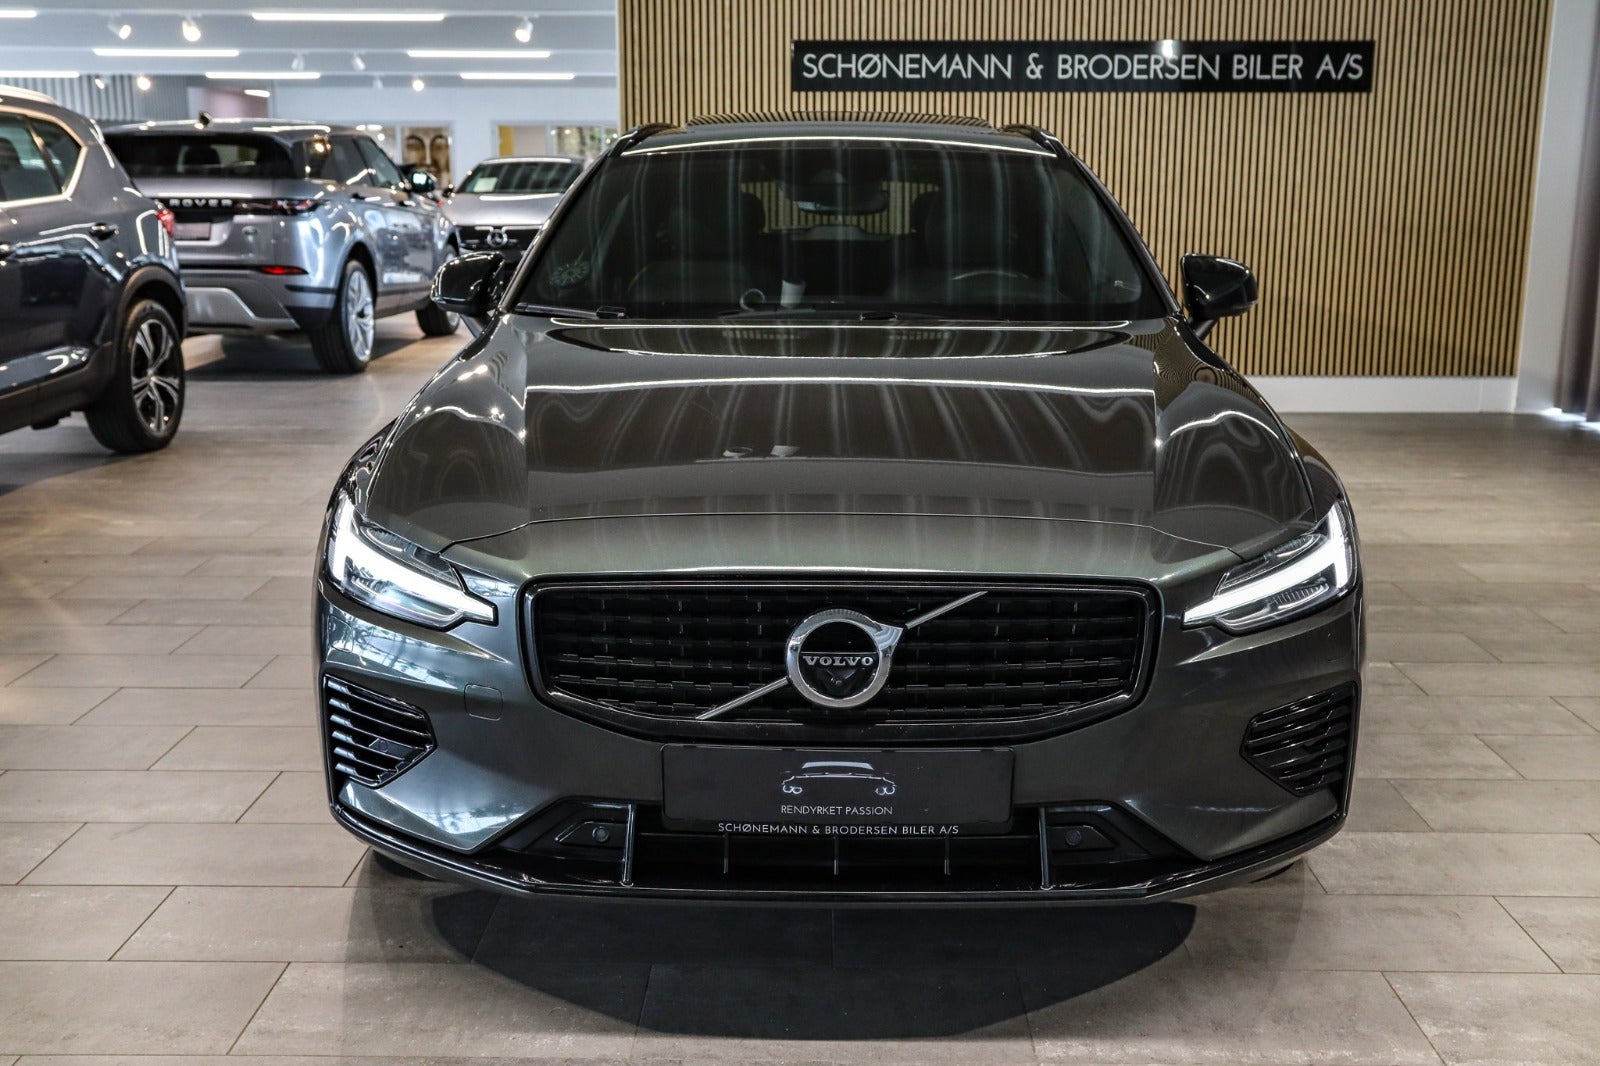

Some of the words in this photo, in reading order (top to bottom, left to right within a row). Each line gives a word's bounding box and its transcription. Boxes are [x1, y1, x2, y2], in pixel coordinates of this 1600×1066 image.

[802, 52, 1013, 80] SCHØNEMANN
[1025, 52, 1045, 80] &
[1056, 53, 1220, 80] BRODERSEN
[1231, 53, 1304, 80] BILER
[1316, 53, 1364, 80] A/S
[169, 199, 233, 208] ROVER
[802, 655, 875, 666] VOLVO
[781, 805, 844, 815] RENDYRKET
[845, 806, 893, 815] PASSION
[718, 823, 808, 834] SCHØNEMANN
[812, 825, 821, 834] &
[825, 825, 897, 835] BRODERSEN
[902, 826, 935, 835] BILER
[940, 825, 960, 835] A/S
